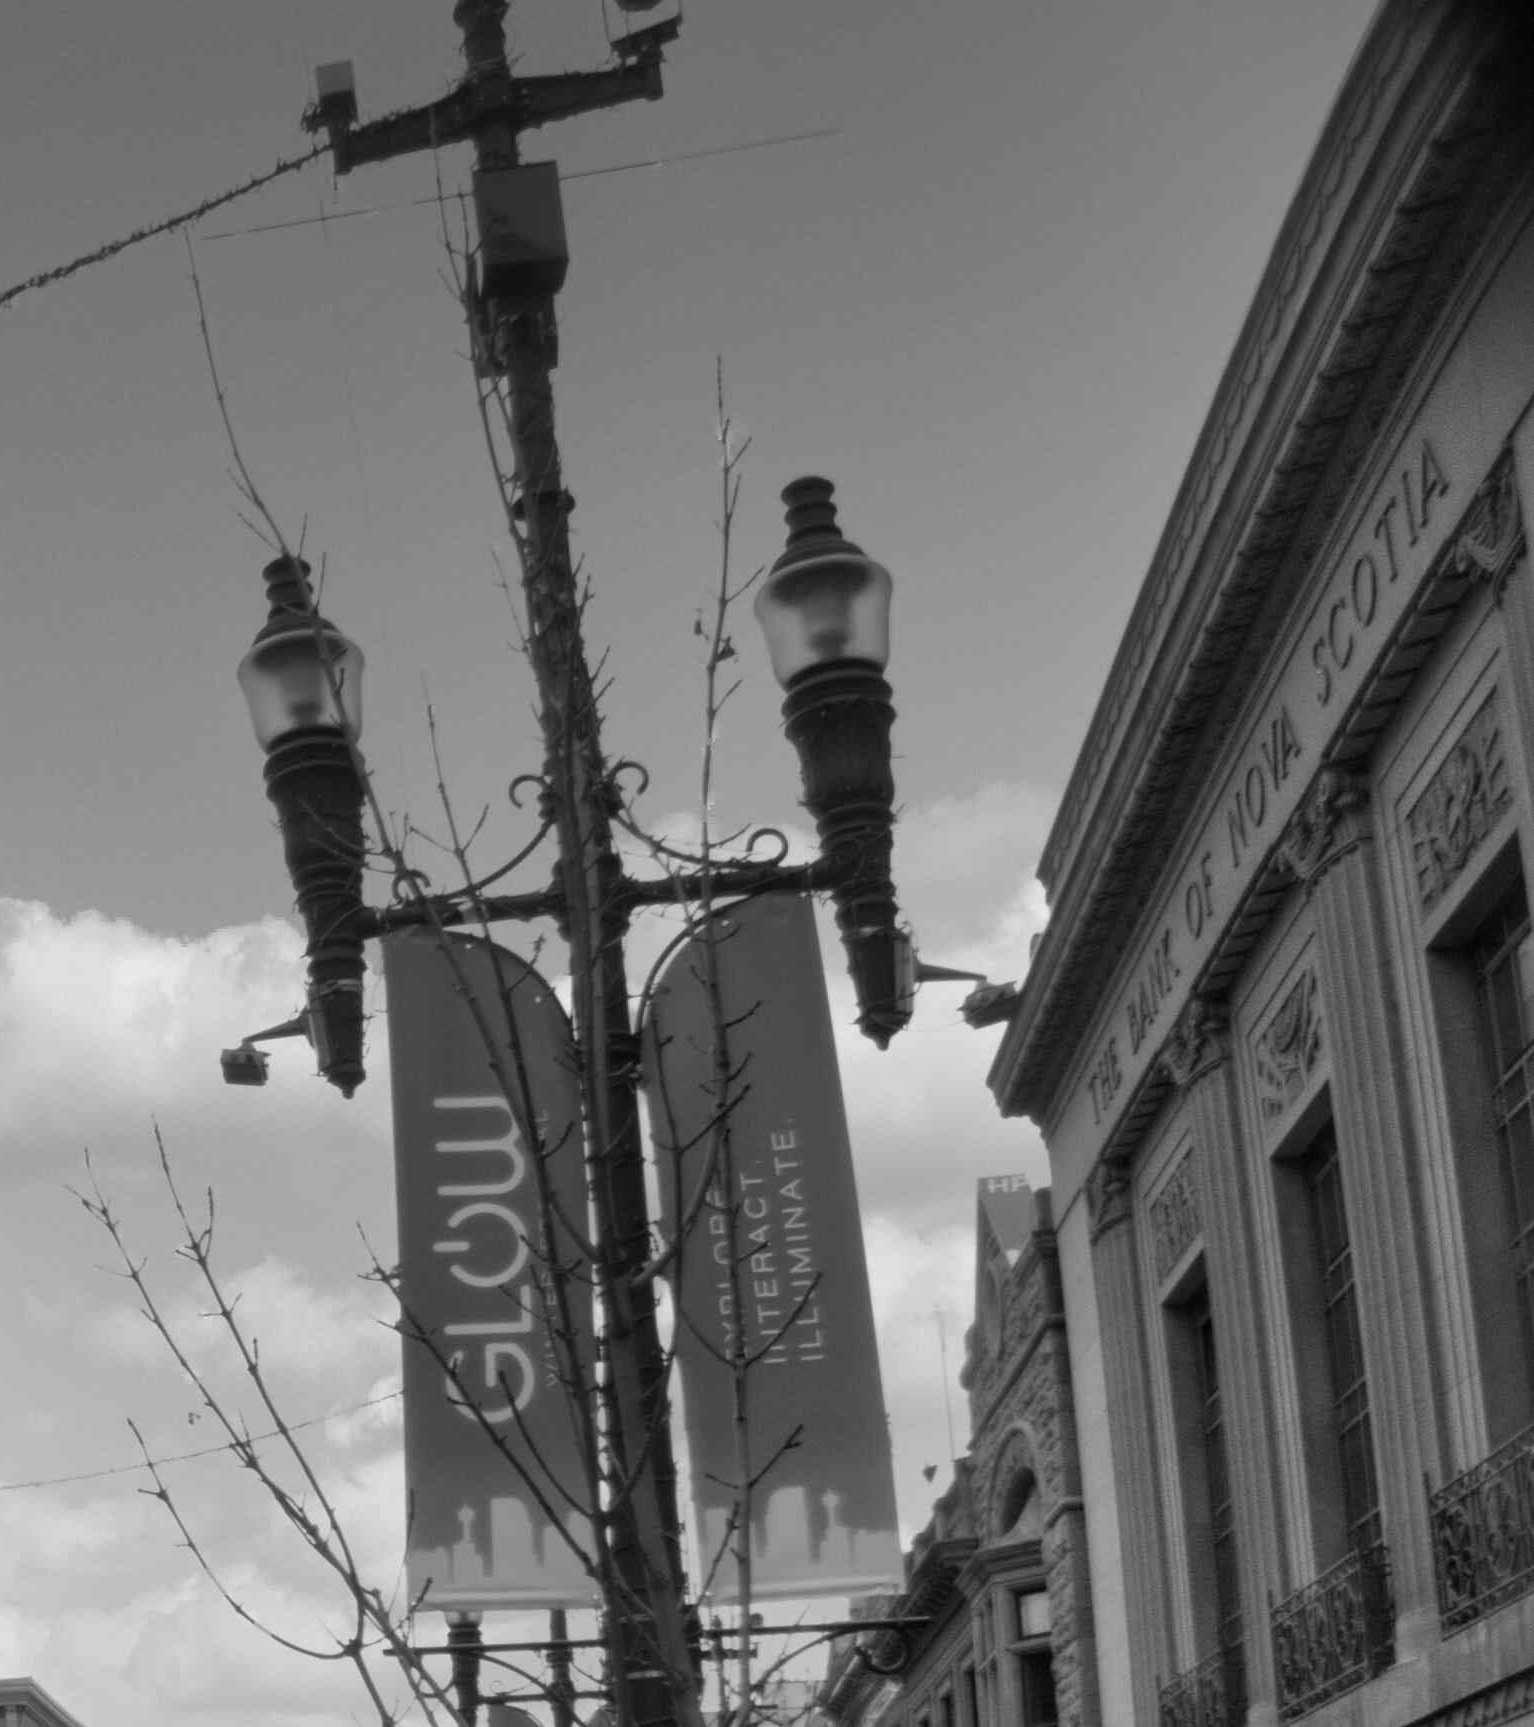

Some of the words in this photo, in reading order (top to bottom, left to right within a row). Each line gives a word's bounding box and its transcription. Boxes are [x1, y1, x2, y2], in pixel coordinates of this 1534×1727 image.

[1087, 1033, 1124, 1127] THE
[1127, 934, 1182, 1057] BANK
[1184, 851, 1216, 941] OF
[1228, 709, 1302, 868] NOVA
[1311, 436, 1451, 708] SCOTIA
